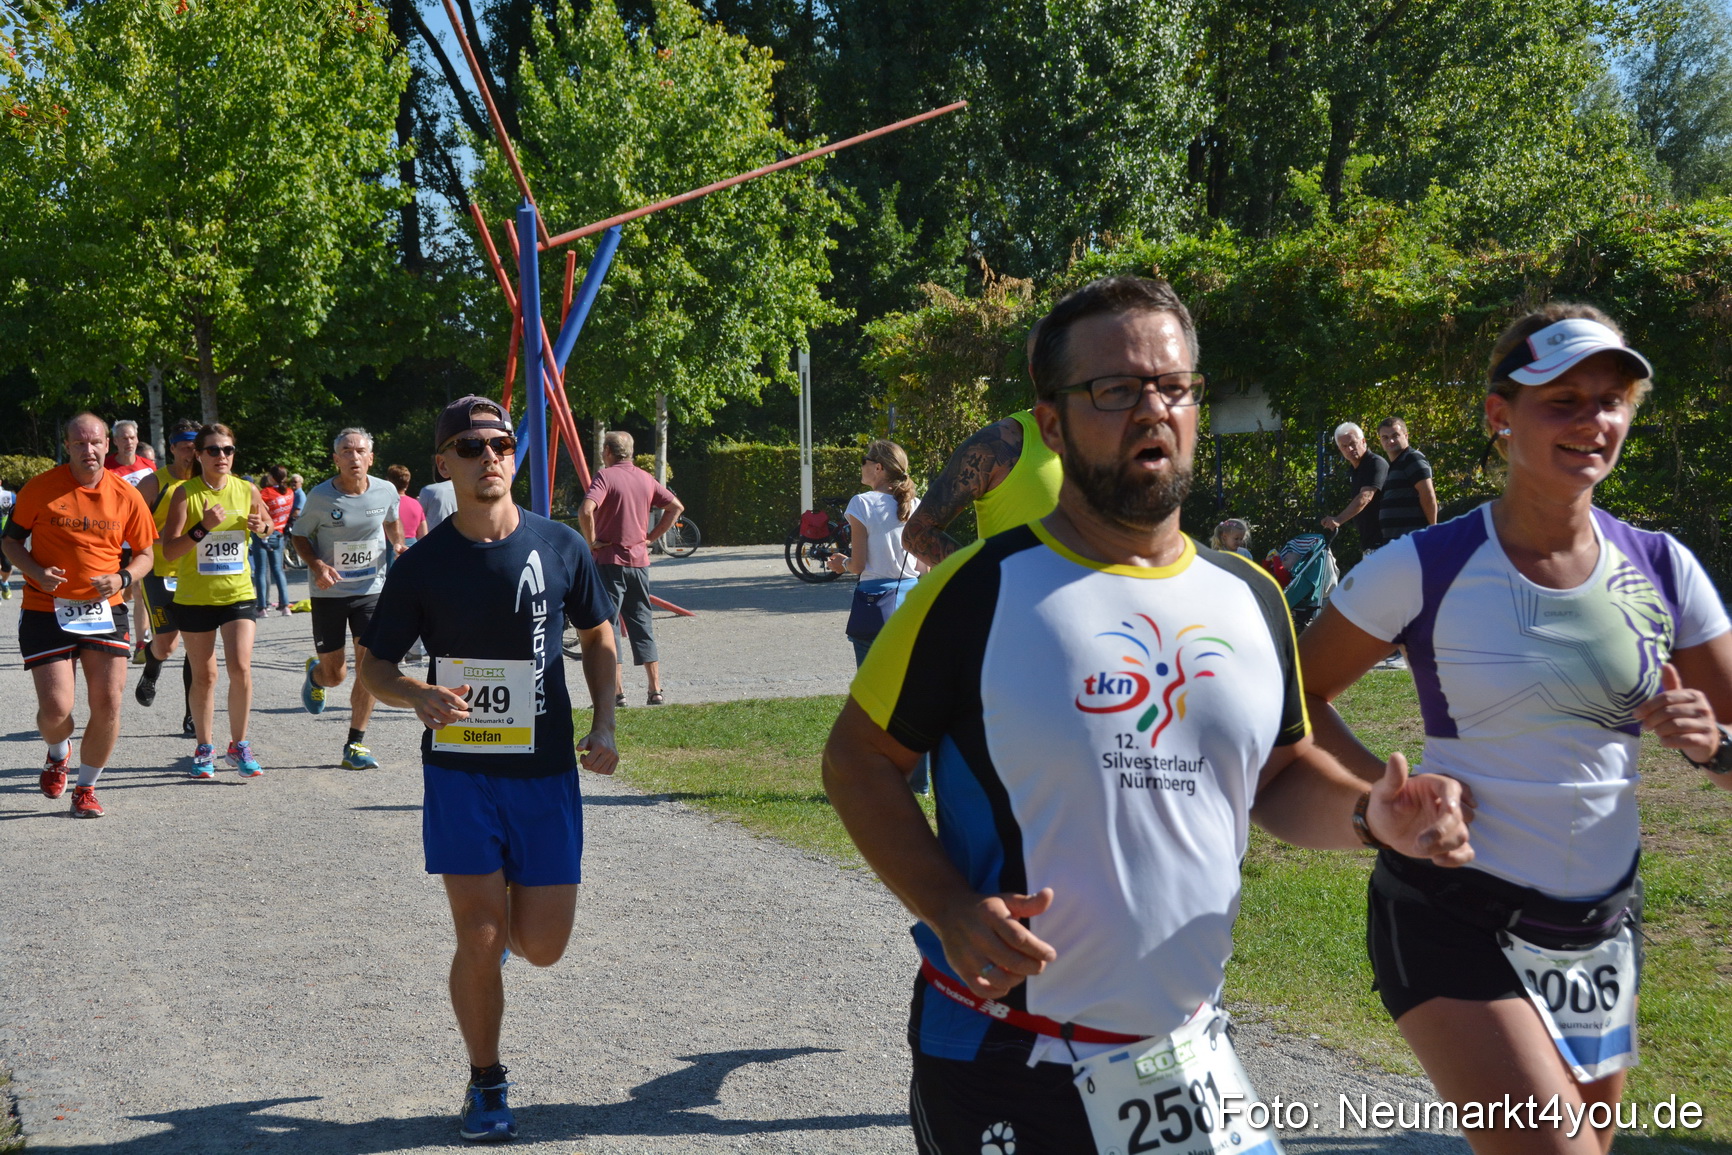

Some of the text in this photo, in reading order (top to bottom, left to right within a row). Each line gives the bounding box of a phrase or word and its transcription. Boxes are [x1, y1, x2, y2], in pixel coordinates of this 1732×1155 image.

[50, 517, 121, 530] EURO POLES
[205, 542, 239, 557] 2198
[341, 551, 372, 565] 2464
[64, 601, 103, 617] 3129
[463, 666, 506, 678] BOCK
[1083, 672, 1133, 695] tkn
[463, 730, 502, 742] Stefan
[1115, 733, 1140, 750] 12.
[1102, 752, 1205, 773] Silvesterlauf
[1119, 772, 1196, 797] Nürnberg
[1559, 1020, 1603, 1029] eumarkt
[1118, 1071, 1232, 1155] 2581
